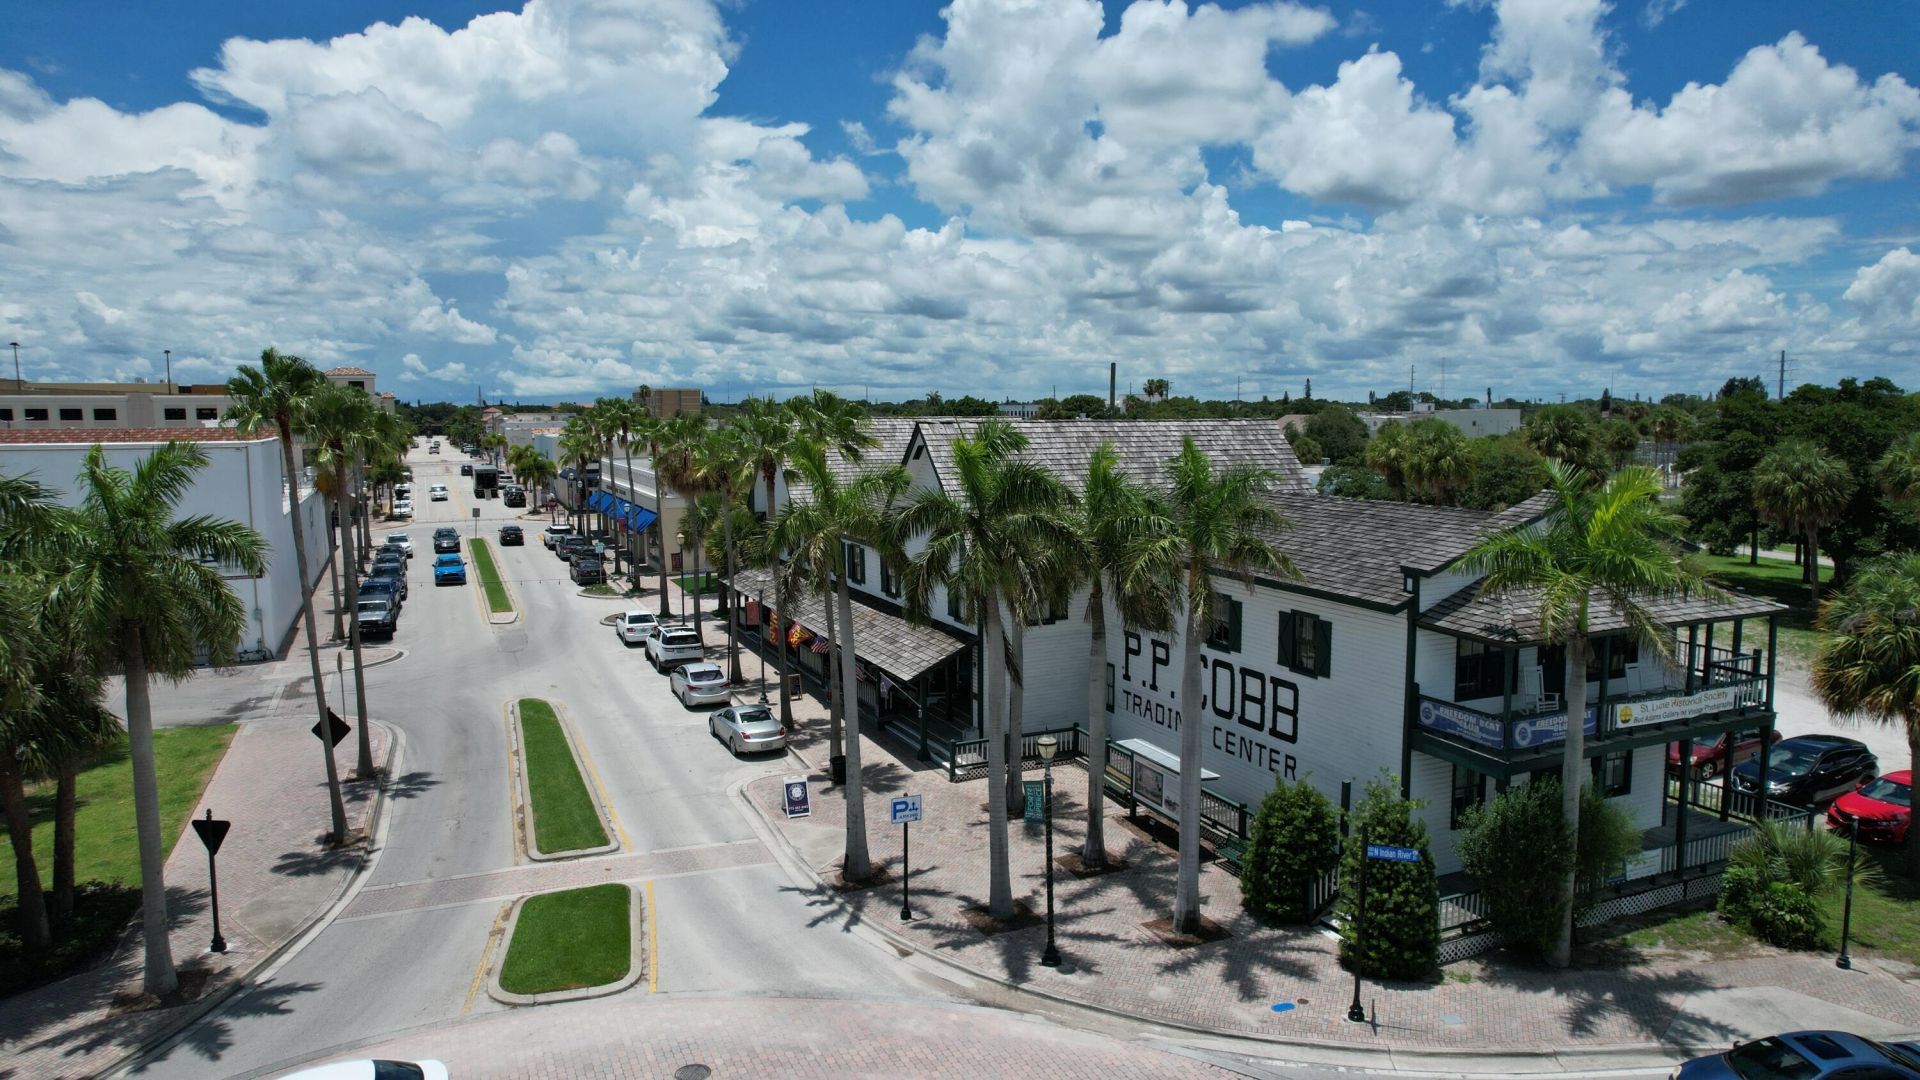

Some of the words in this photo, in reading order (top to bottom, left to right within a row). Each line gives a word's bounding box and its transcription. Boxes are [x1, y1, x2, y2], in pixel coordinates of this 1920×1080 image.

[1122, 630, 1175, 699] P.P.
[1703, 690, 1729, 702] Society
[1123, 690, 1182, 732] TRADIN
[1213, 726, 1296, 781] CENTER
[1380, 847, 1397, 858] Indian
[1397, 849, 1412, 860] River
